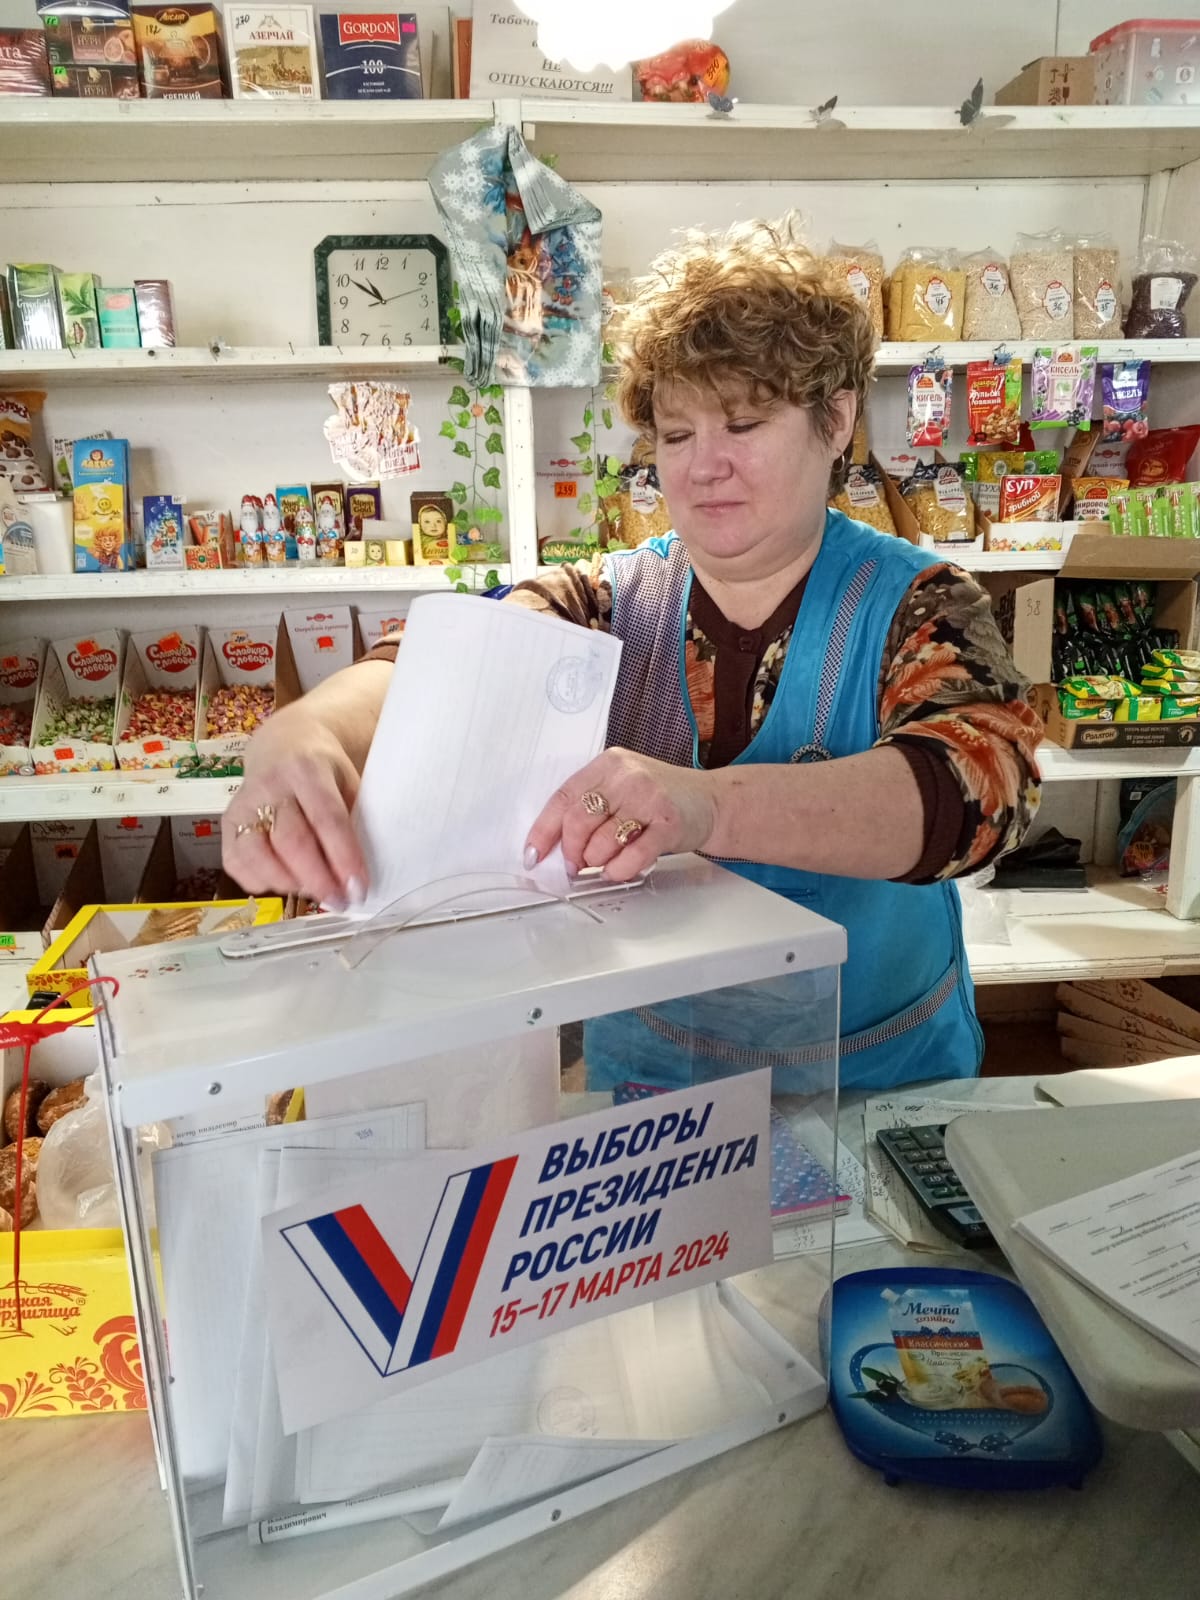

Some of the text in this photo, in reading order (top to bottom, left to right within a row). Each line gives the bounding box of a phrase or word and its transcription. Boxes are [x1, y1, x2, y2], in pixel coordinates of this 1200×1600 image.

[249, 30, 294, 41] АЗЕРЧАЙ
[343, 22, 395, 36] GORDON
[361, 60, 384, 74] 100
[488, 72, 614, 93] ОТПУСКАЮТСЯ!!!
[354, 257, 365, 271] 11
[374, 256, 389, 270] 12
[401, 256, 407, 270] 1
[336, 273, 350, 288] 10
[418, 272, 428, 286] 2
[339, 296, 349, 310] 9
[419, 294, 429, 309] 3
[340, 319, 350, 334] 8
[420, 318, 430, 331] 4
[359, 332, 370, 346] 7
[381, 333, 391, 347] 6
[403, 332, 413, 346] 5
[1006, 479, 1034, 494] Суп
[1008, 491, 1041, 513] грибной
[538, 1102, 714, 1184] ВЫБОРЫ
[519, 1134, 759, 1238] ПРЕЗИДЕНТА
[501, 1208, 662, 1292] РОССИИ
[569, 1252, 662, 1309] МАРТА
[667, 1231, 729, 1277] 2024
[902, 1302, 960, 1316] Мечта
[0, 1306, 80, 1327] рмилица
[267, 1511, 327, 1534] Владимирович
